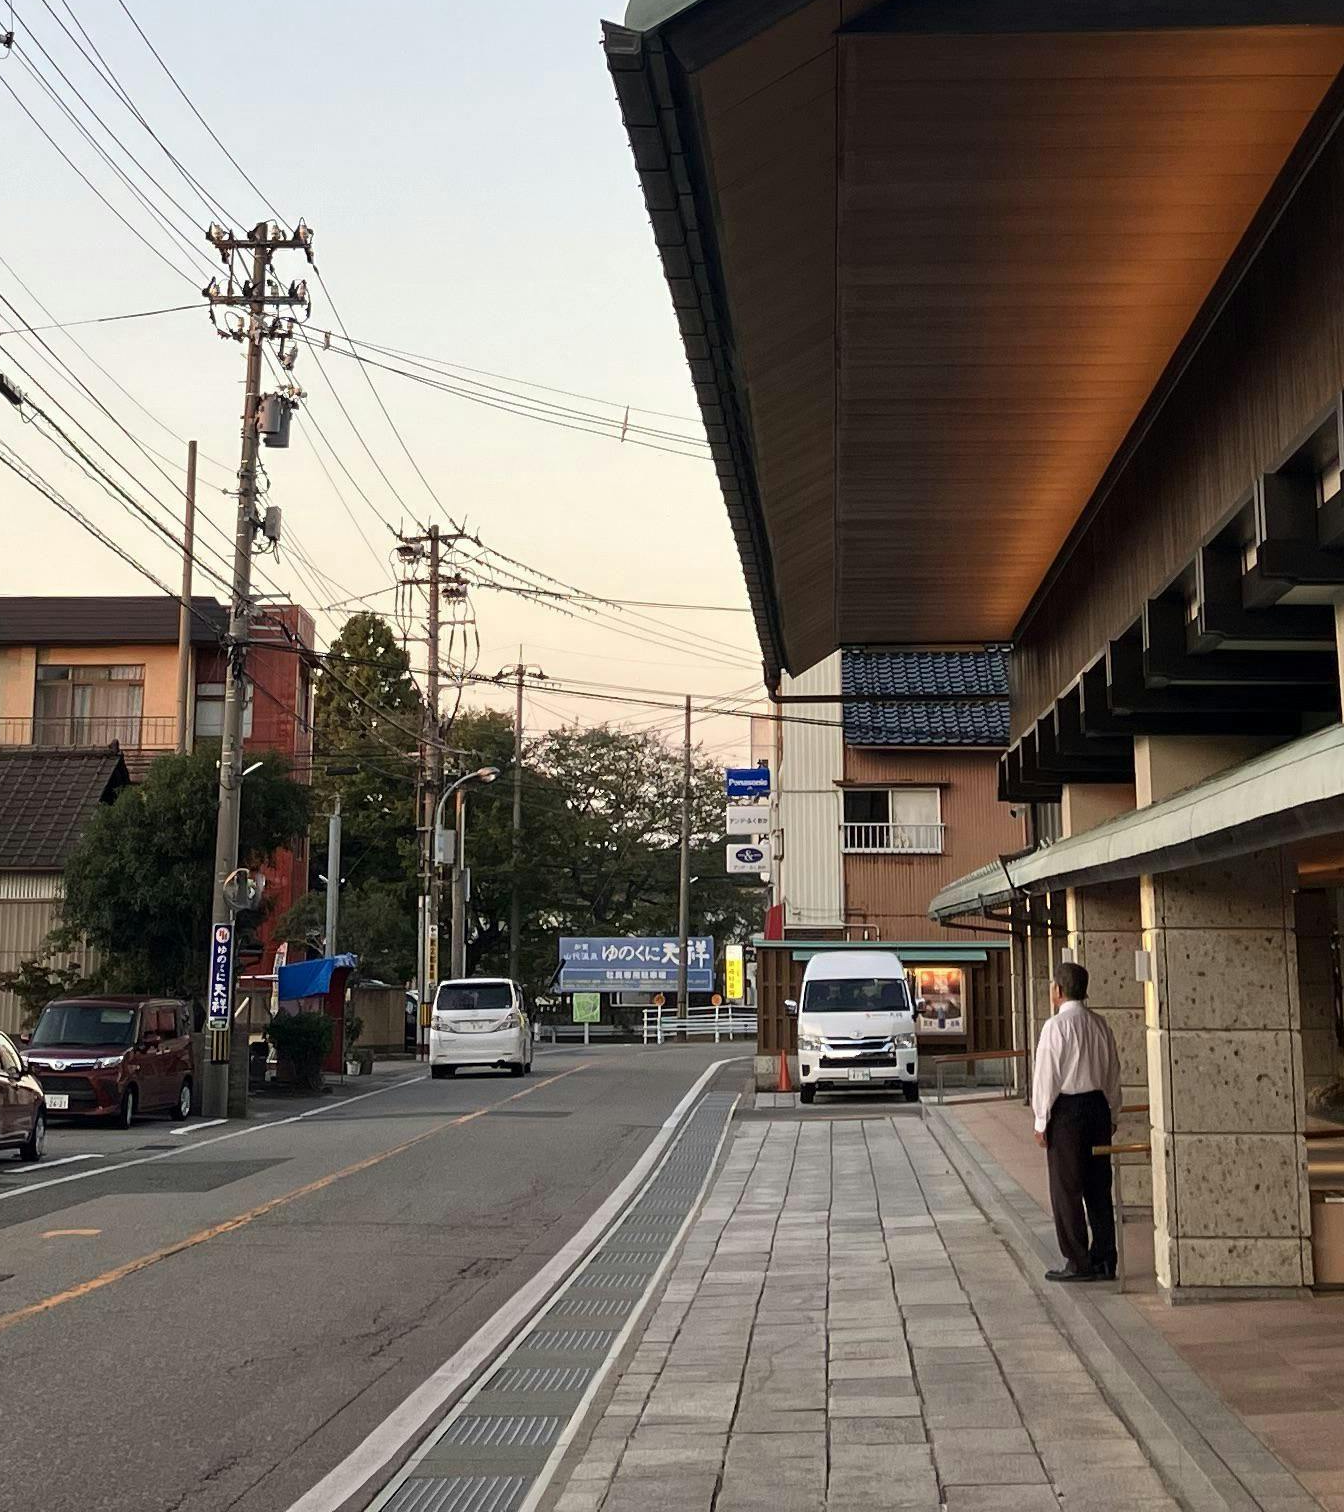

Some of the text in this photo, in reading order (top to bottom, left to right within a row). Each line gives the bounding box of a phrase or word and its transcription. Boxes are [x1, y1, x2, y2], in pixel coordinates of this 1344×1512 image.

[728, 778, 768, 786] Panasonic
[212, 945, 228, 1015] ゆのくに天祥
